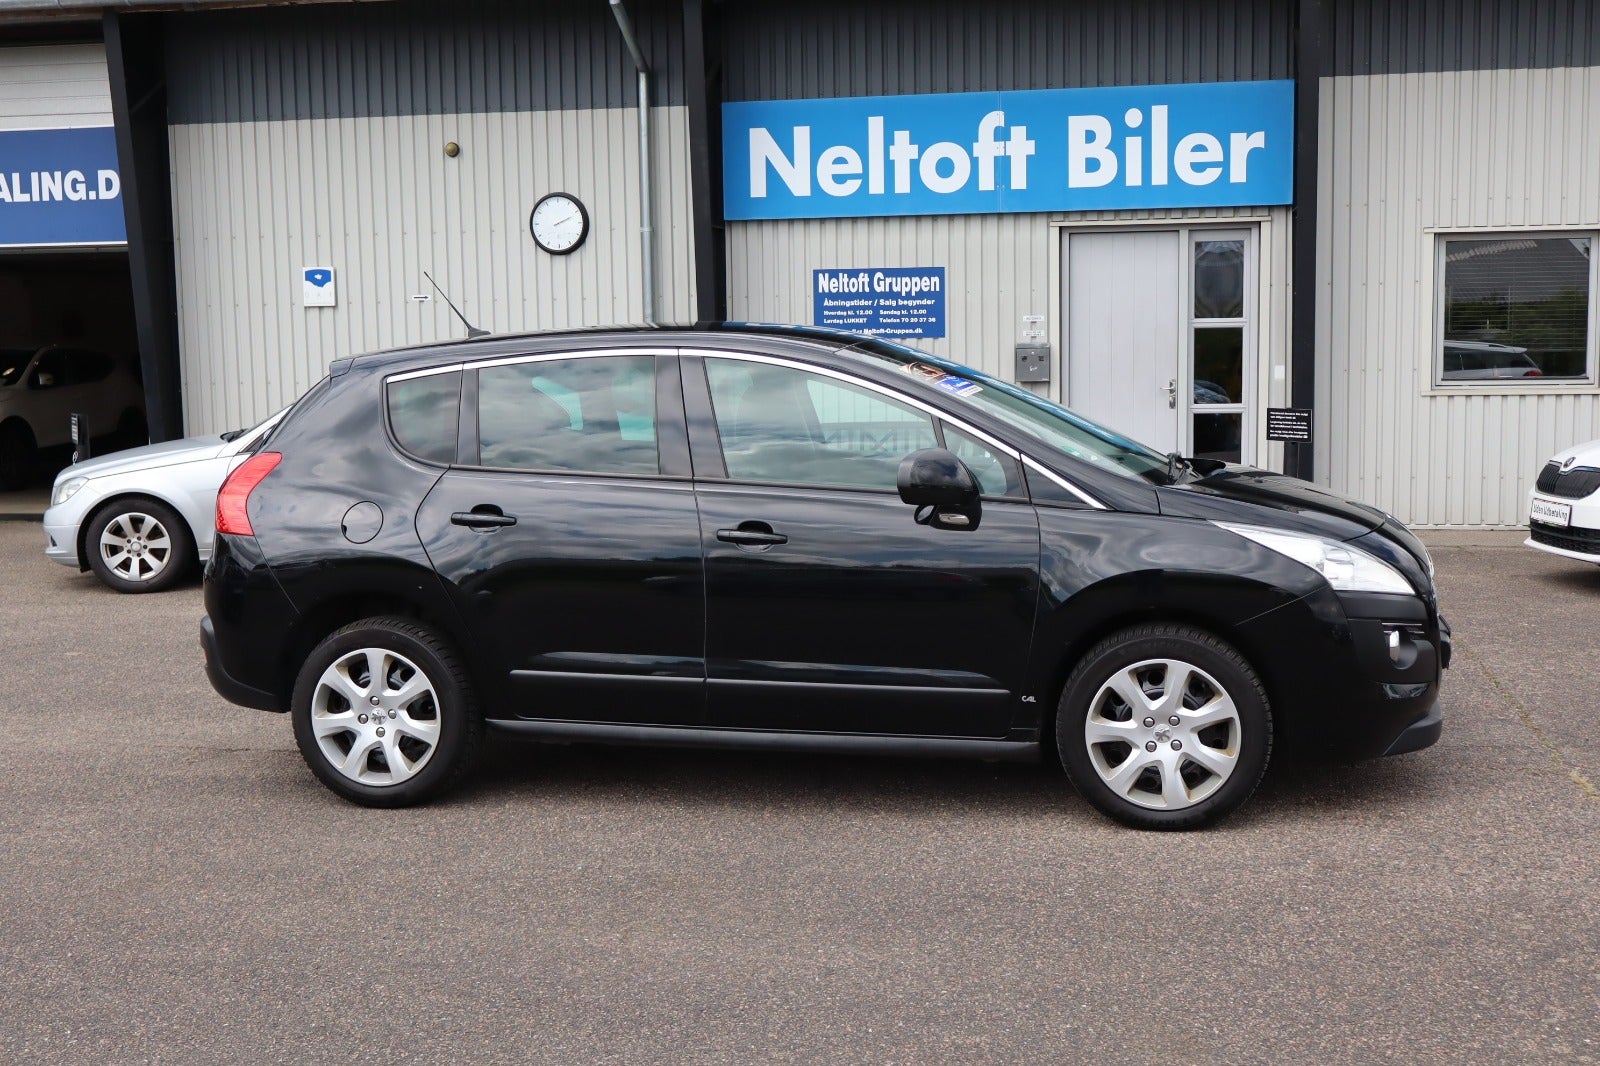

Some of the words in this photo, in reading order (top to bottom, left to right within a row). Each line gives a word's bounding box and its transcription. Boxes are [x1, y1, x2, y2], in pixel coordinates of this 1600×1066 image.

[749, 110, 1036, 198] Neltoft
[1068, 104, 1265, 189] Biler
[818, 272, 870, 293] Neltoft
[873, 271, 940, 296] Gruppen
[824, 298, 872, 307] Åbningstider
[879, 299, 897, 307] Salg
[898, 299, 936, 307] begynder
